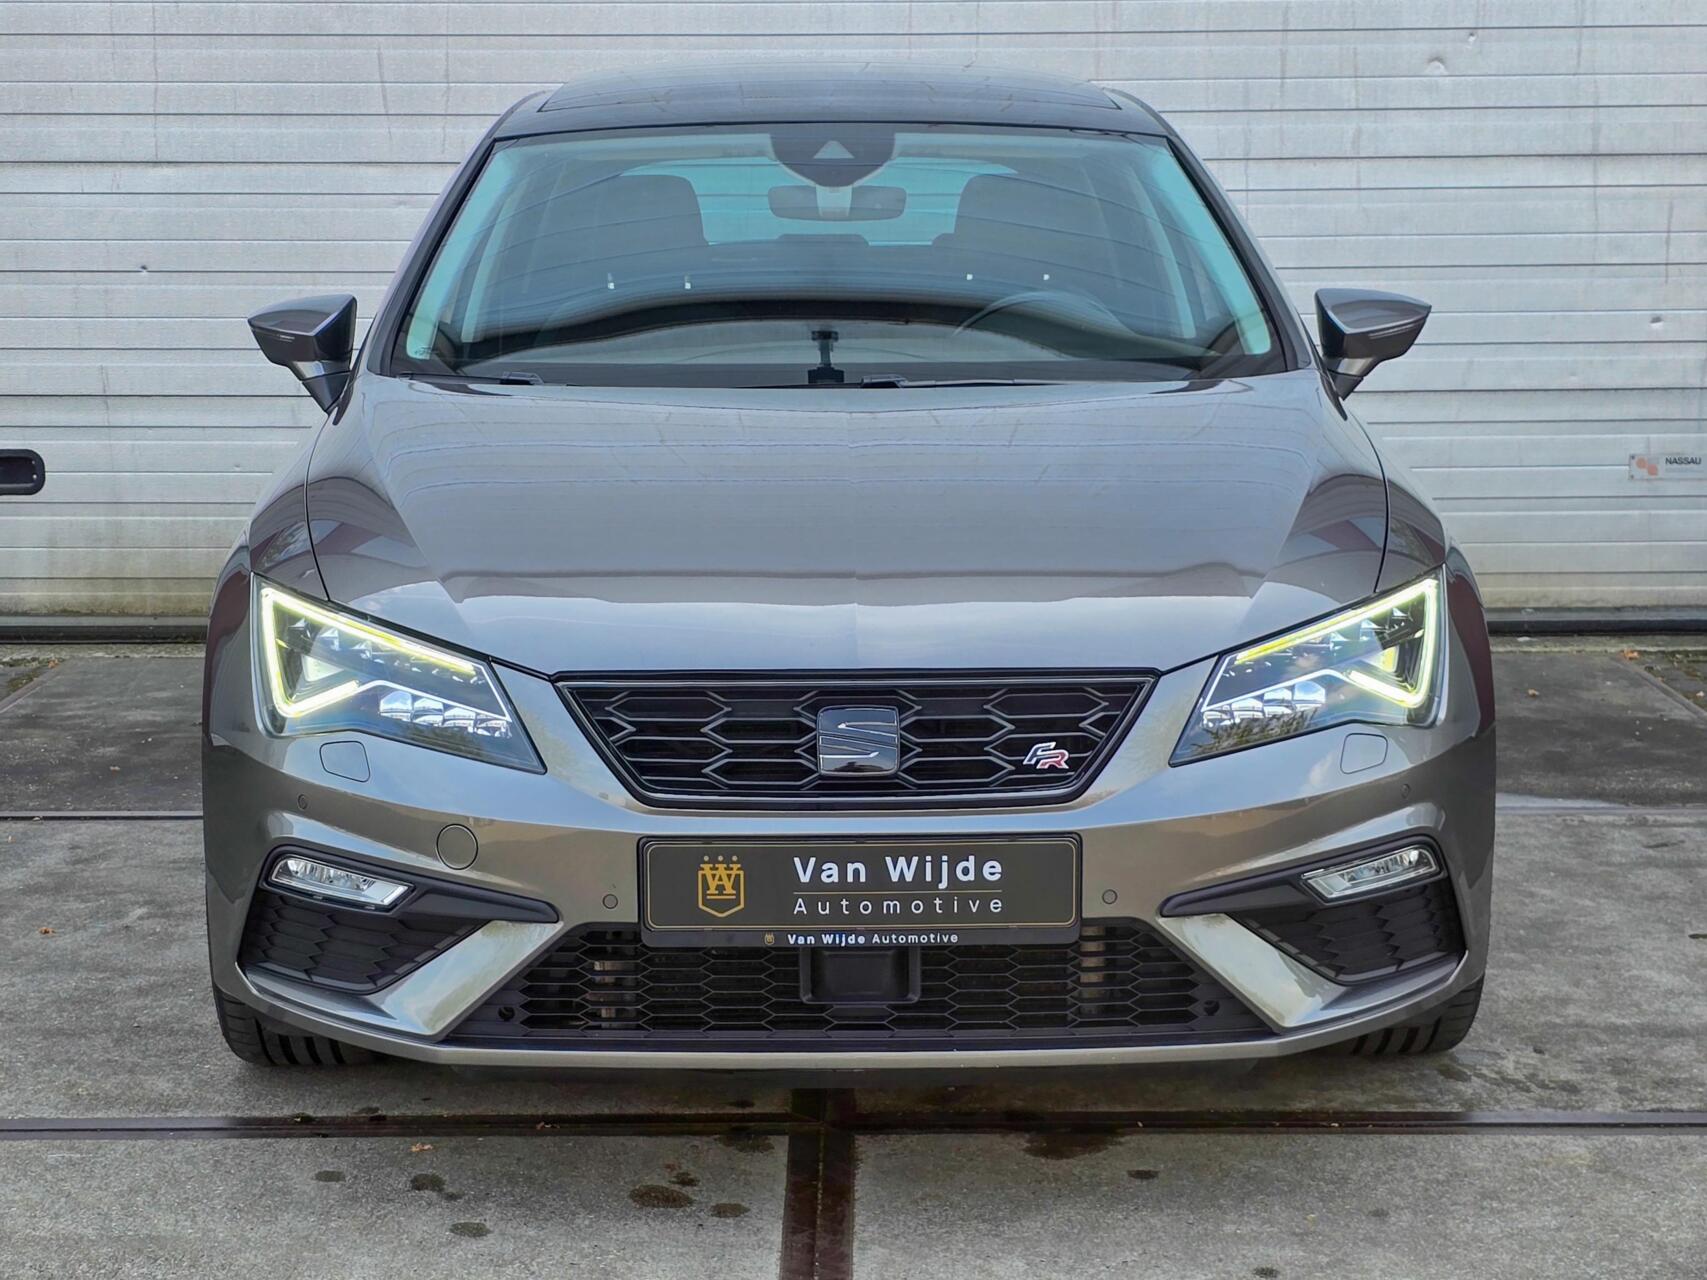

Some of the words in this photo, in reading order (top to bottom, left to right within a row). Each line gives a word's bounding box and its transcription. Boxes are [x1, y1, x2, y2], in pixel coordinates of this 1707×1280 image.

[1665, 457, 1701, 465] NASSAU
[1023, 741, 1070, 770] FR
[793, 856, 866, 883] Van
[885, 855, 1003, 890] Wijde
[793, 895, 1003, 915] Automotive
[787, 933, 816, 945] Van
[821, 932, 866, 947] Wijde
[872, 932, 959, 944] Automotive
